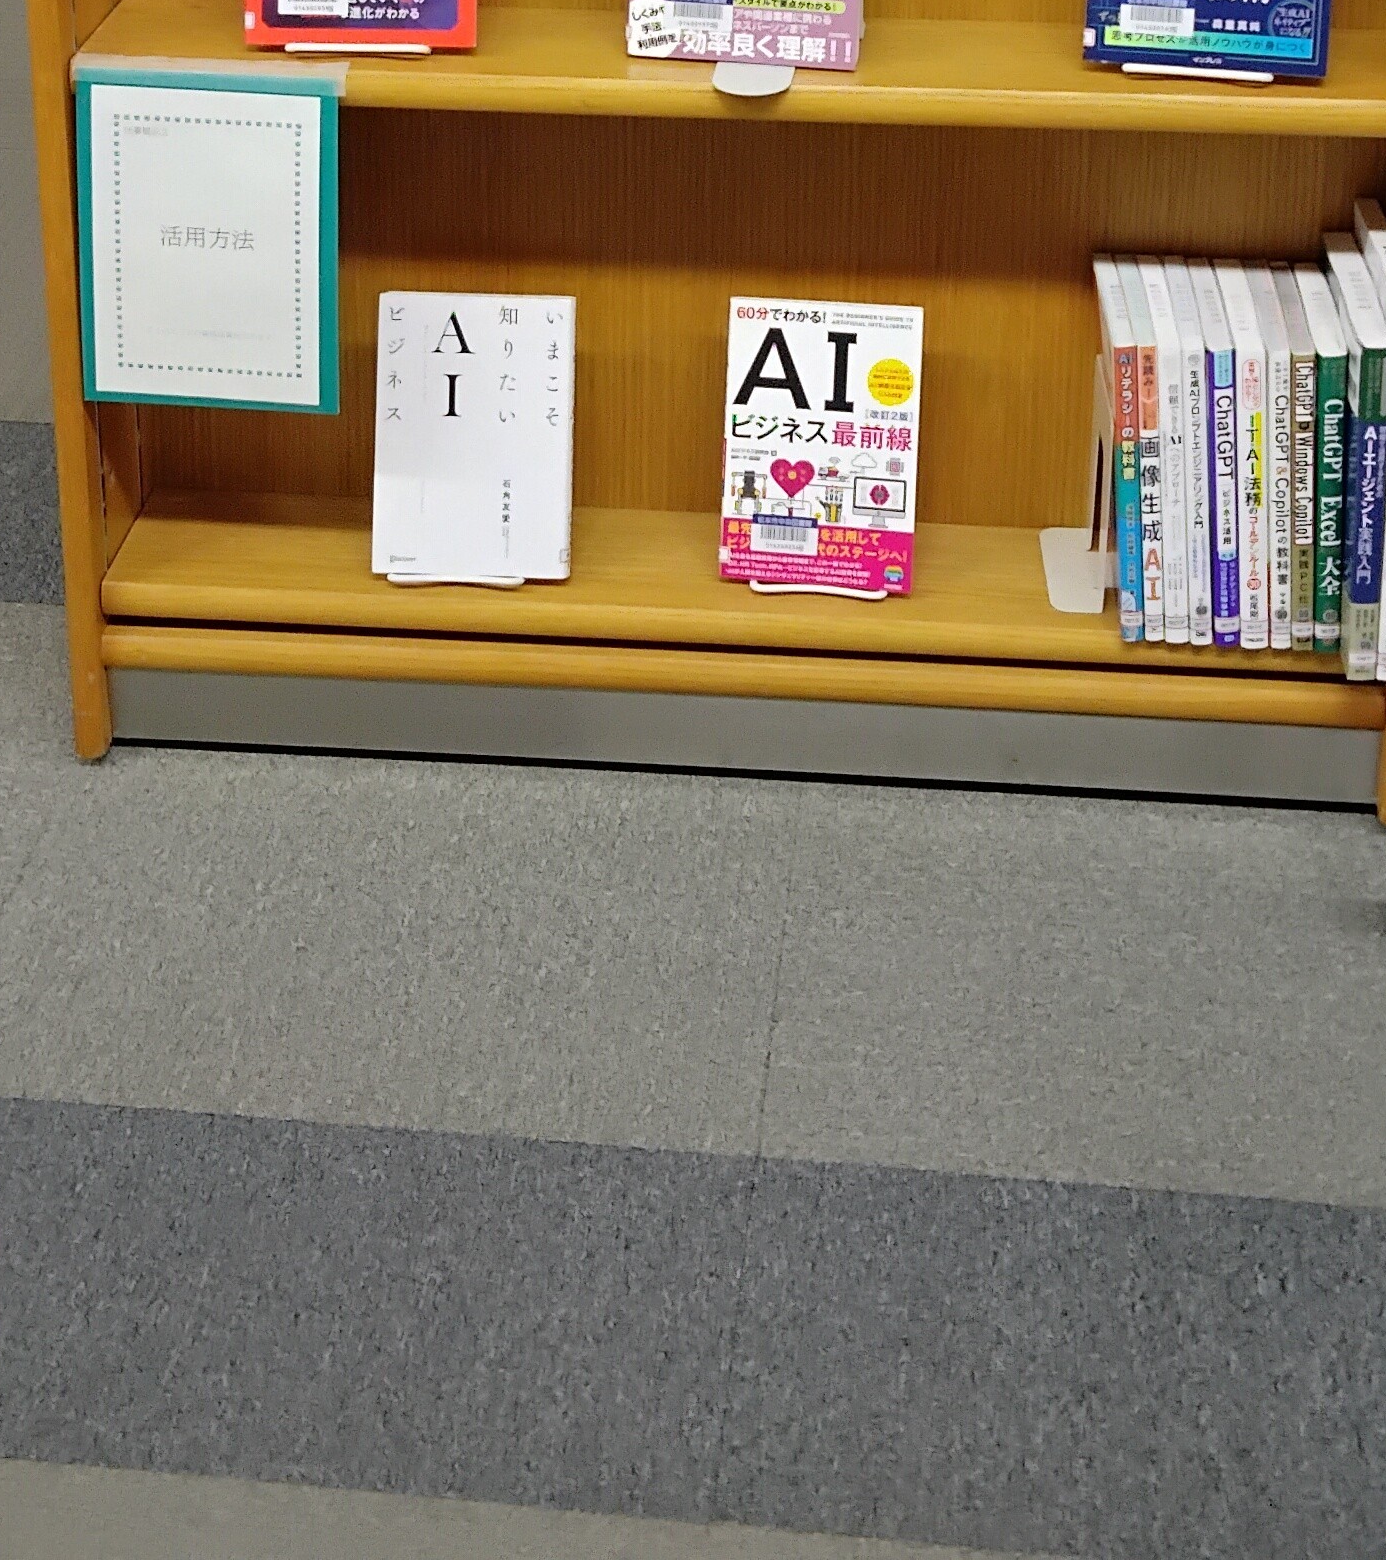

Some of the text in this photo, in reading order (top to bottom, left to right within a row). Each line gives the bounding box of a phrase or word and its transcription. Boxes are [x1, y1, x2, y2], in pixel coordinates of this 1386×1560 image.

[160, 225, 255, 252] 活用方法
[385, 305, 406, 421] ビジネス
[431, 310, 476, 418] AI
[498, 305, 518, 424] 知りたい
[545, 309, 563, 427] いまこそ
[736, 306, 827, 324] 60分でわかる！
[732, 327, 857, 413] AI
[731, 413, 913, 452] ビジネス最前線
[1216, 395, 1234, 480] ChatGPT
[1141, 437, 1162, 600] 画像生成AI
[1319, 398, 1345, 596] ChatGPT Excel 大全
